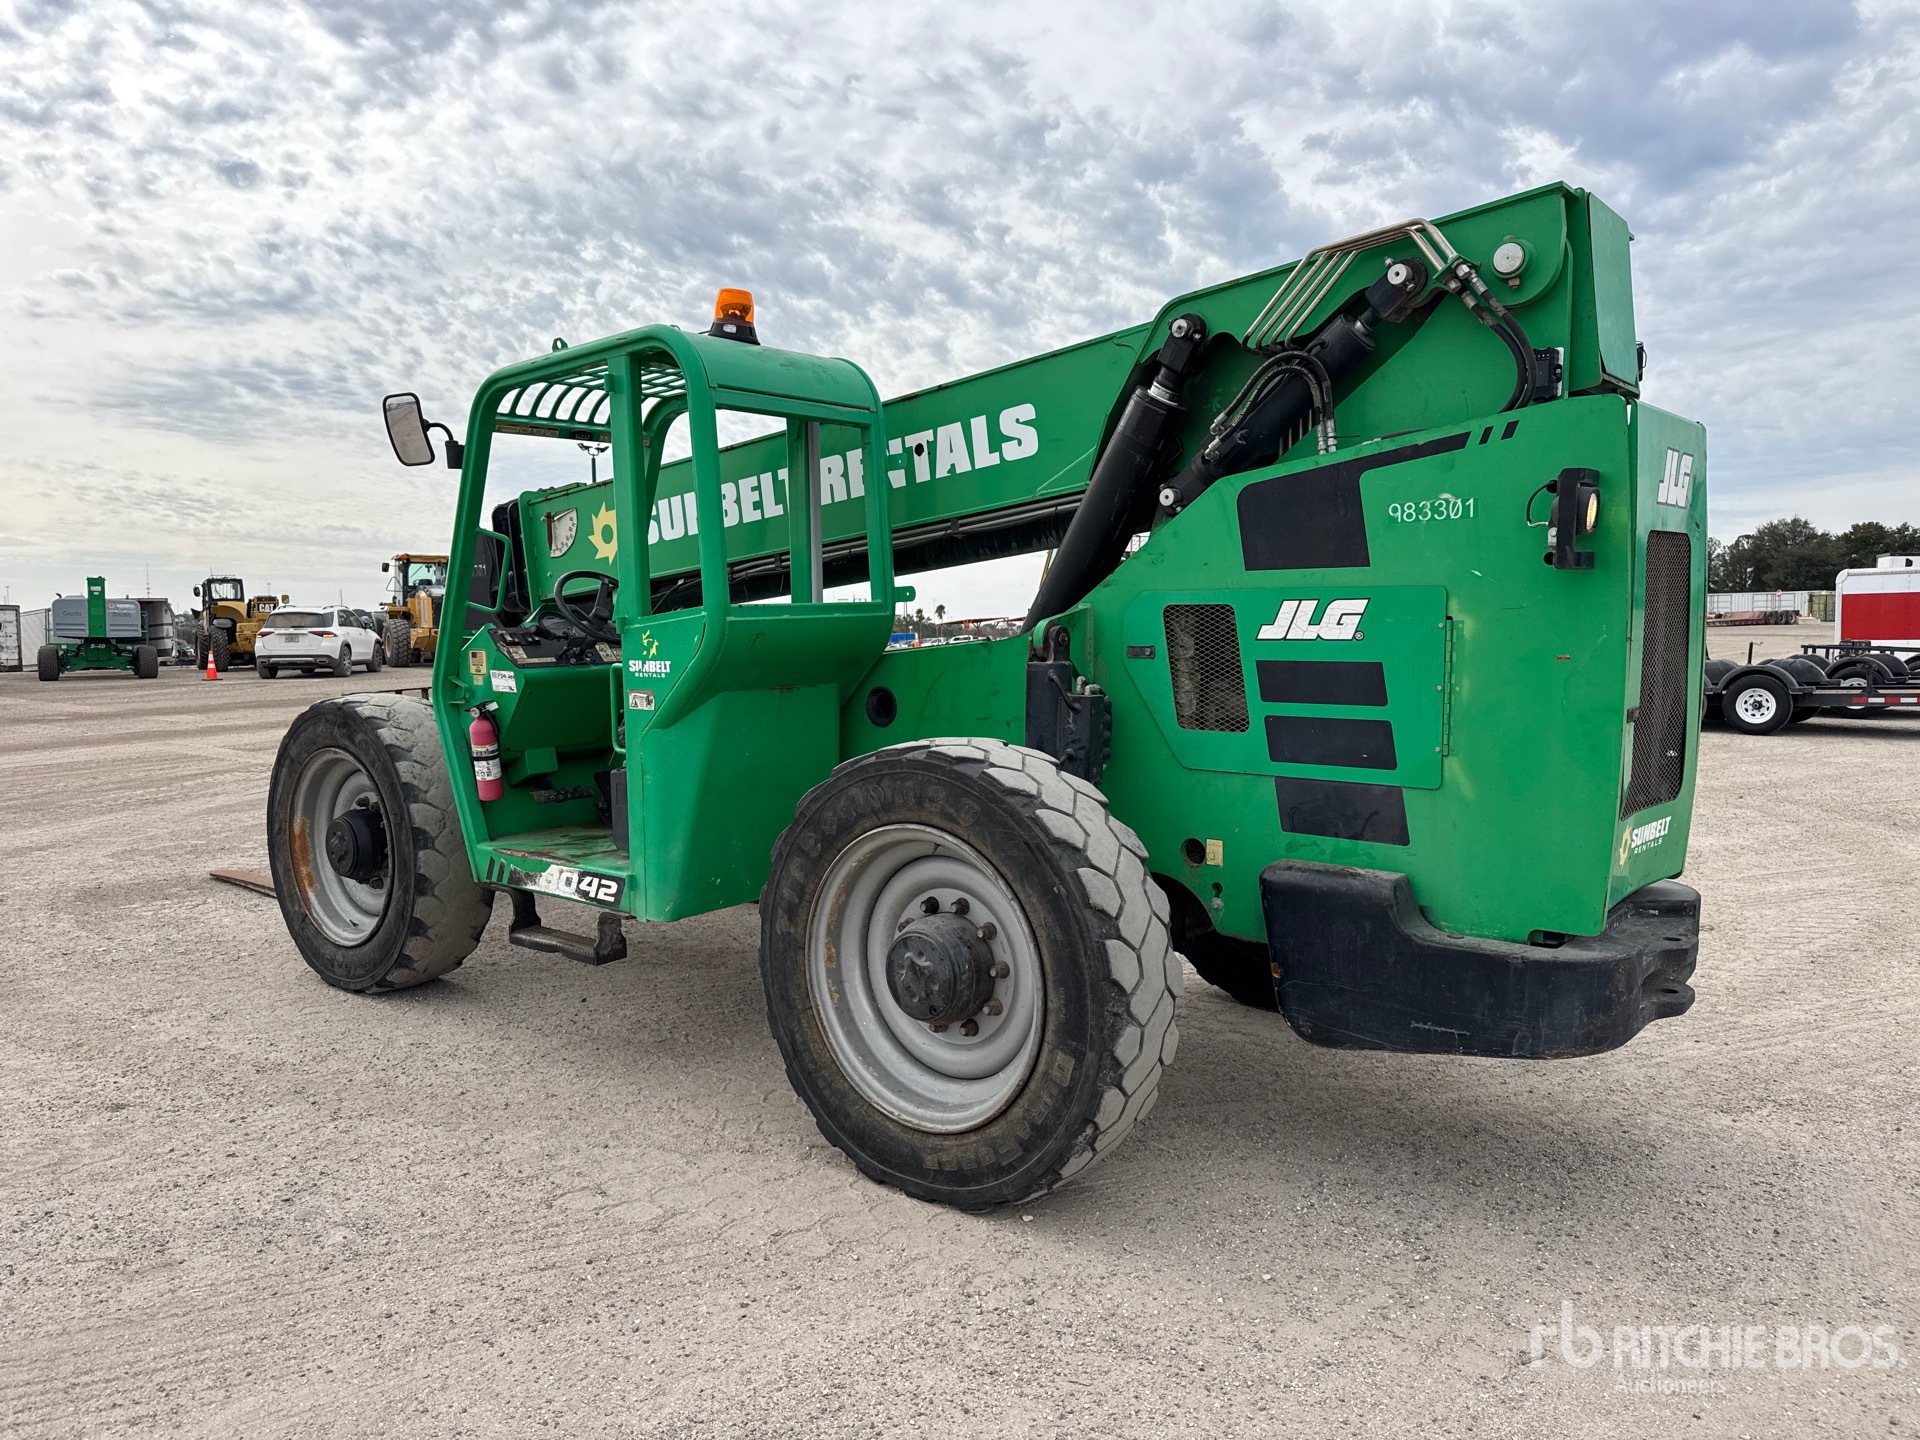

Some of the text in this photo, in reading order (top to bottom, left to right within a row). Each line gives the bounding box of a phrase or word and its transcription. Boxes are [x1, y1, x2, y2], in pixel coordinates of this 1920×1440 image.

[1657, 447, 1694, 510] JLG
[1388, 497, 1474, 523] 983301
[258, 603, 276, 613] CAT
[628, 660, 671, 673] SUNBELT
[1631, 816, 1672, 849] SUNBELT
[1633, 837, 1663, 855] RENTALS
